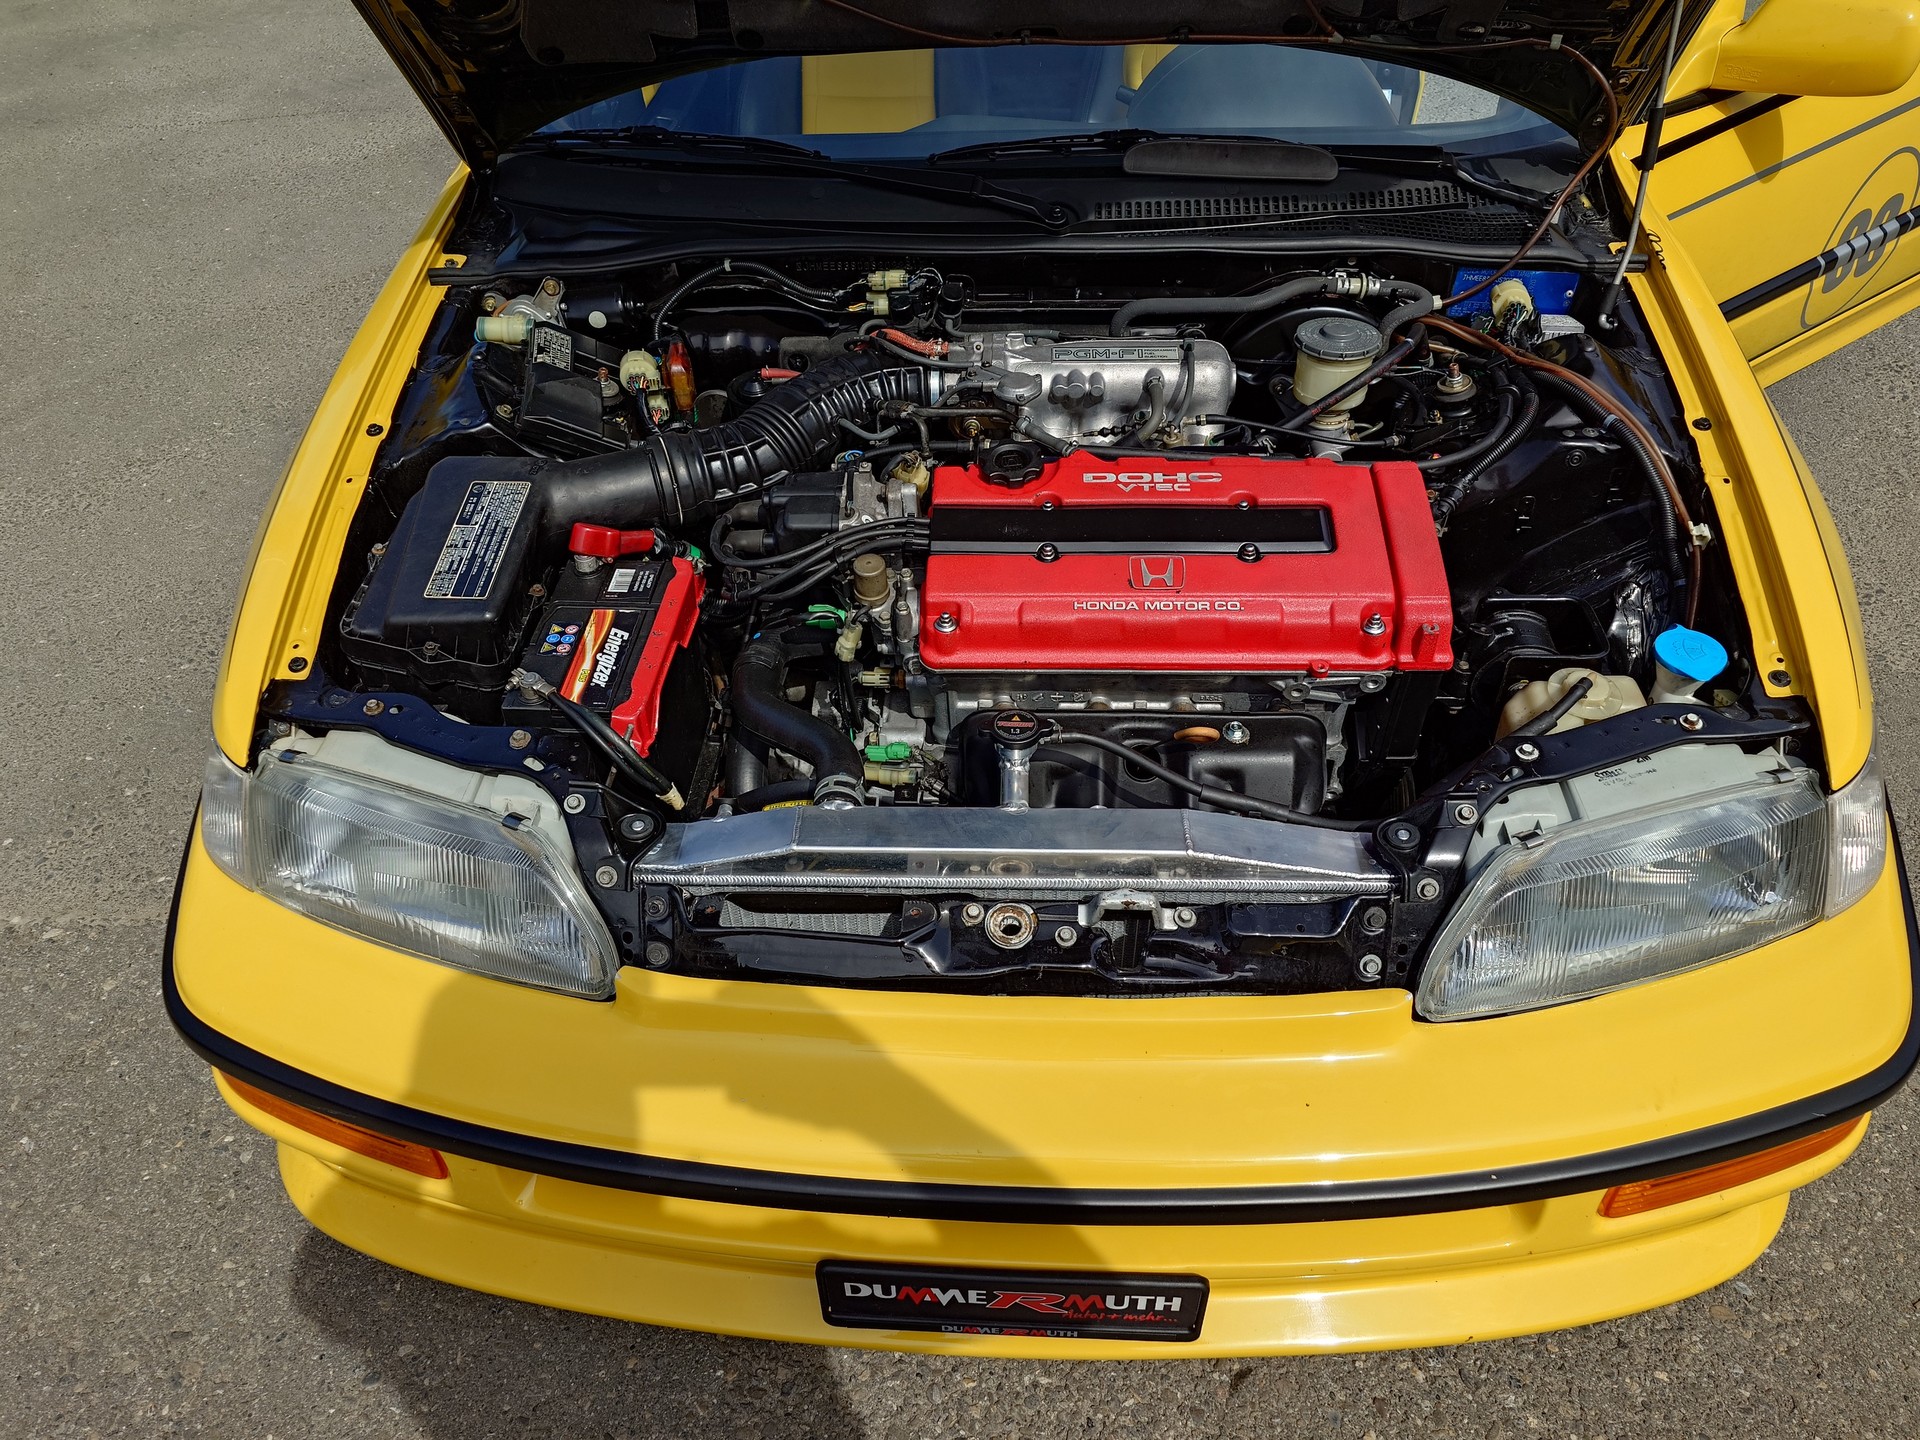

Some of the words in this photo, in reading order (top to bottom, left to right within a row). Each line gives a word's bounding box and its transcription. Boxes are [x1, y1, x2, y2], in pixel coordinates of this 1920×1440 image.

[1055, 348, 1144, 359] PGM-FI
[1083, 472, 1223, 483] DOHC
[1117, 483, 1191, 492] VTEC
[1073, 601, 1139, 611] HONDA
[1144, 601, 1210, 611] MOTOR
[1214, 601, 1245, 611] CO.
